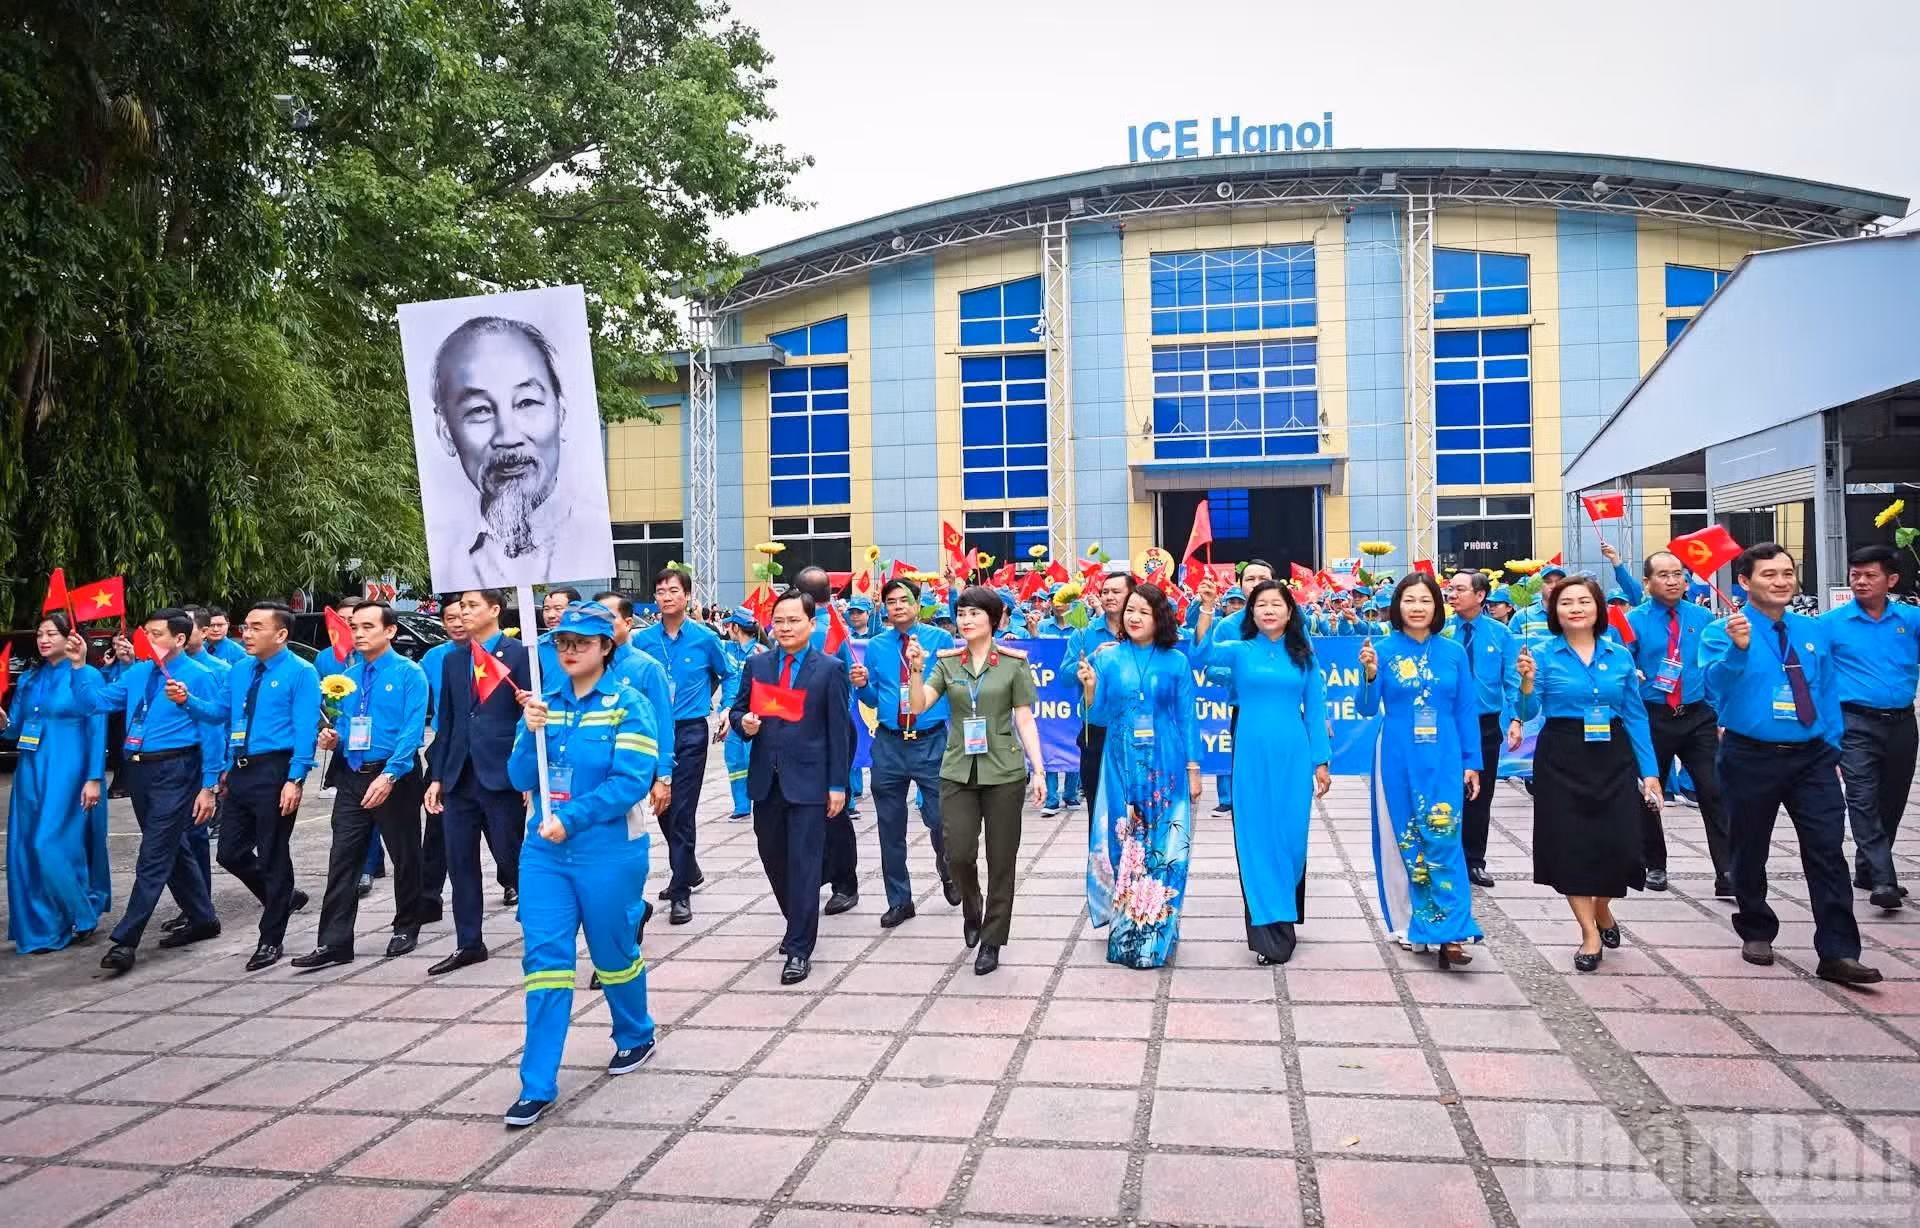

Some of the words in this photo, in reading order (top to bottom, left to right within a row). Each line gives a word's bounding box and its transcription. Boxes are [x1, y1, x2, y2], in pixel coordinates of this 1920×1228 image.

[1128, 119, 1198, 162] ICE
[1213, 111, 1333, 153] Hanoi
[1492, 541, 1499, 550] 2
